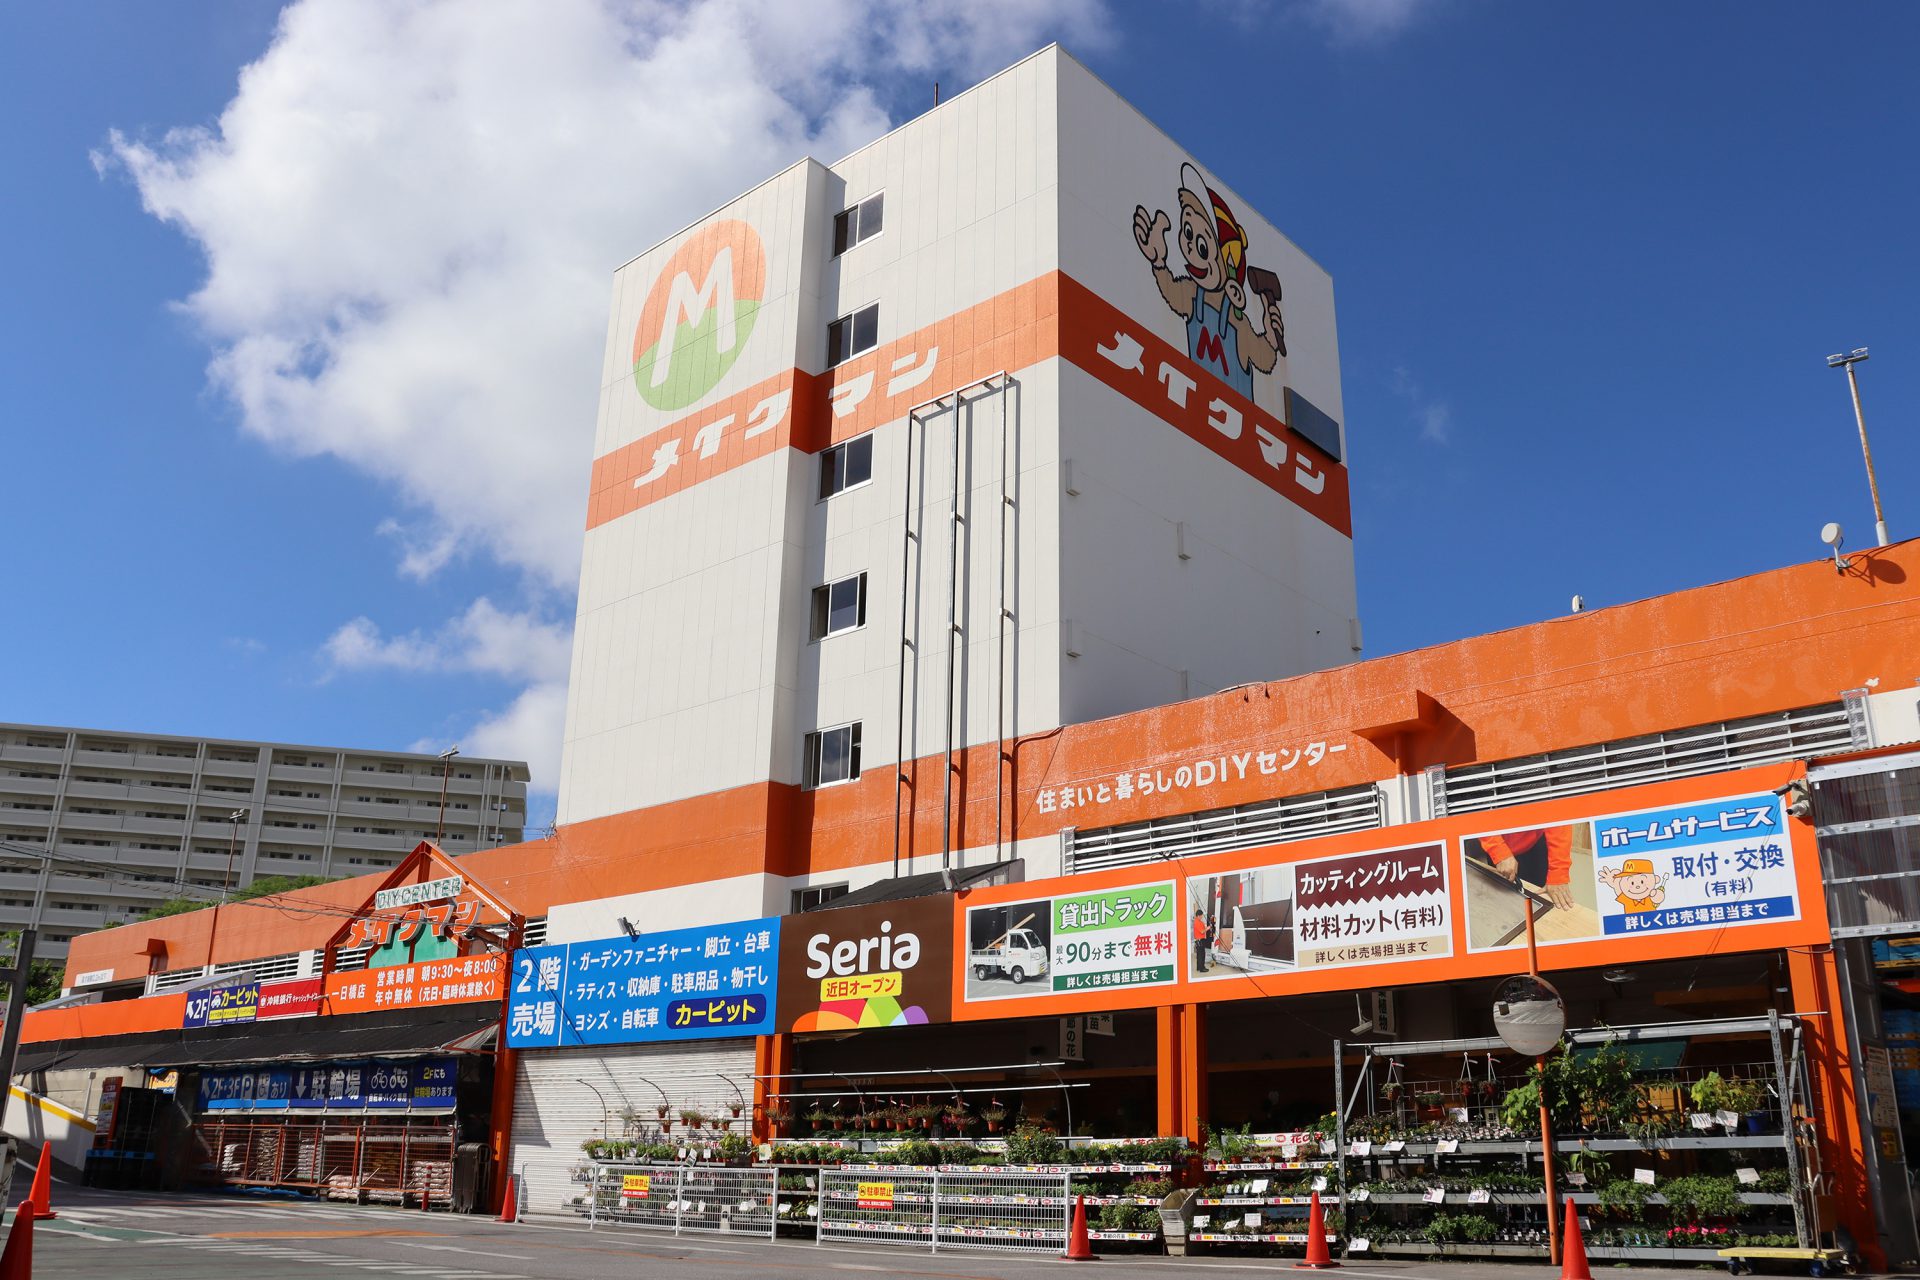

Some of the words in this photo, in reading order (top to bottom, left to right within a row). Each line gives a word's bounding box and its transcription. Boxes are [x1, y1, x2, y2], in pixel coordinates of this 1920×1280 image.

[650, 246, 737, 388] M
[1196, 326, 1229, 376] M
[633, 346, 939, 489] メイクマン
[1096, 330, 1325, 495] メイクマン
[1036, 741, 1347, 814] 住まいと暮らしのDIYセンター
[1601, 804, 1776, 848] ホームサービス
[1300, 856, 1439, 896] カッティングルーム
[1672, 843, 1785, 880] 取付・交換
[1704, 876, 1754, 898] (有料)
[1058, 892, 1168, 930] 貸出トラック
[1300, 904, 1444, 942] 材料カット(有料)
[1625, 902, 1769, 930] 詳しくは売場担当まで
[806, 920, 920, 979] Seria
[1315, 940, 1428, 963] 詳しくは売場担当まで
[377, 967, 415, 987] 営業時間
[516, 956, 562, 994] 2階
[825, 977, 897, 998] 近日オープン
[1066, 969, 1160, 988] 詳しくは売場担当まで
[193, 998, 208, 1019] 2F
[375, 989, 412, 1006] 年中無休
[675, 998, 756, 1026] カーピット
[511, 1001, 556, 1038] 売場
[311, 1069, 361, 1100] 駐輪場
